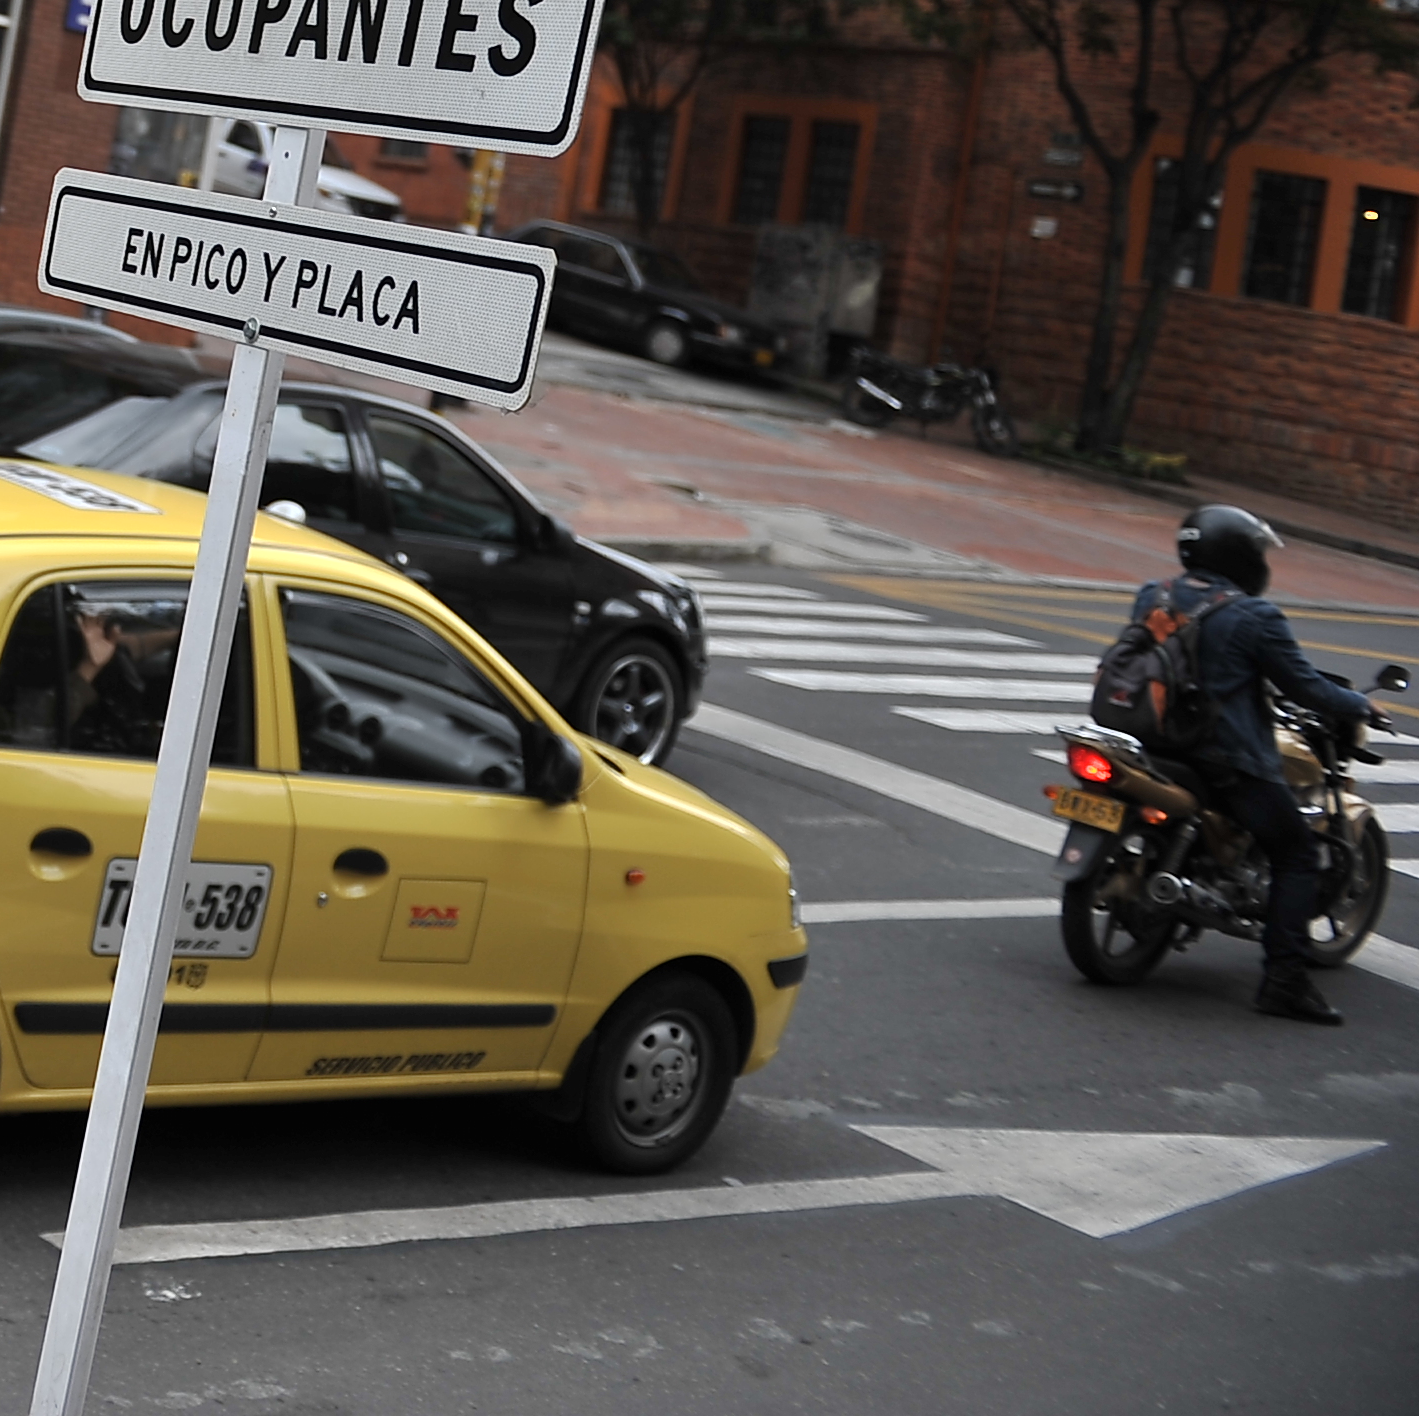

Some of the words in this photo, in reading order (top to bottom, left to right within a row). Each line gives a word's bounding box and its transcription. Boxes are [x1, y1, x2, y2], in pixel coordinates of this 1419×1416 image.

[121, 226, 165, 278] EN
[169, 235, 248, 295] PICO
[262, 251, 287, 303] Y
[291, 259, 420, 335] PLACA
